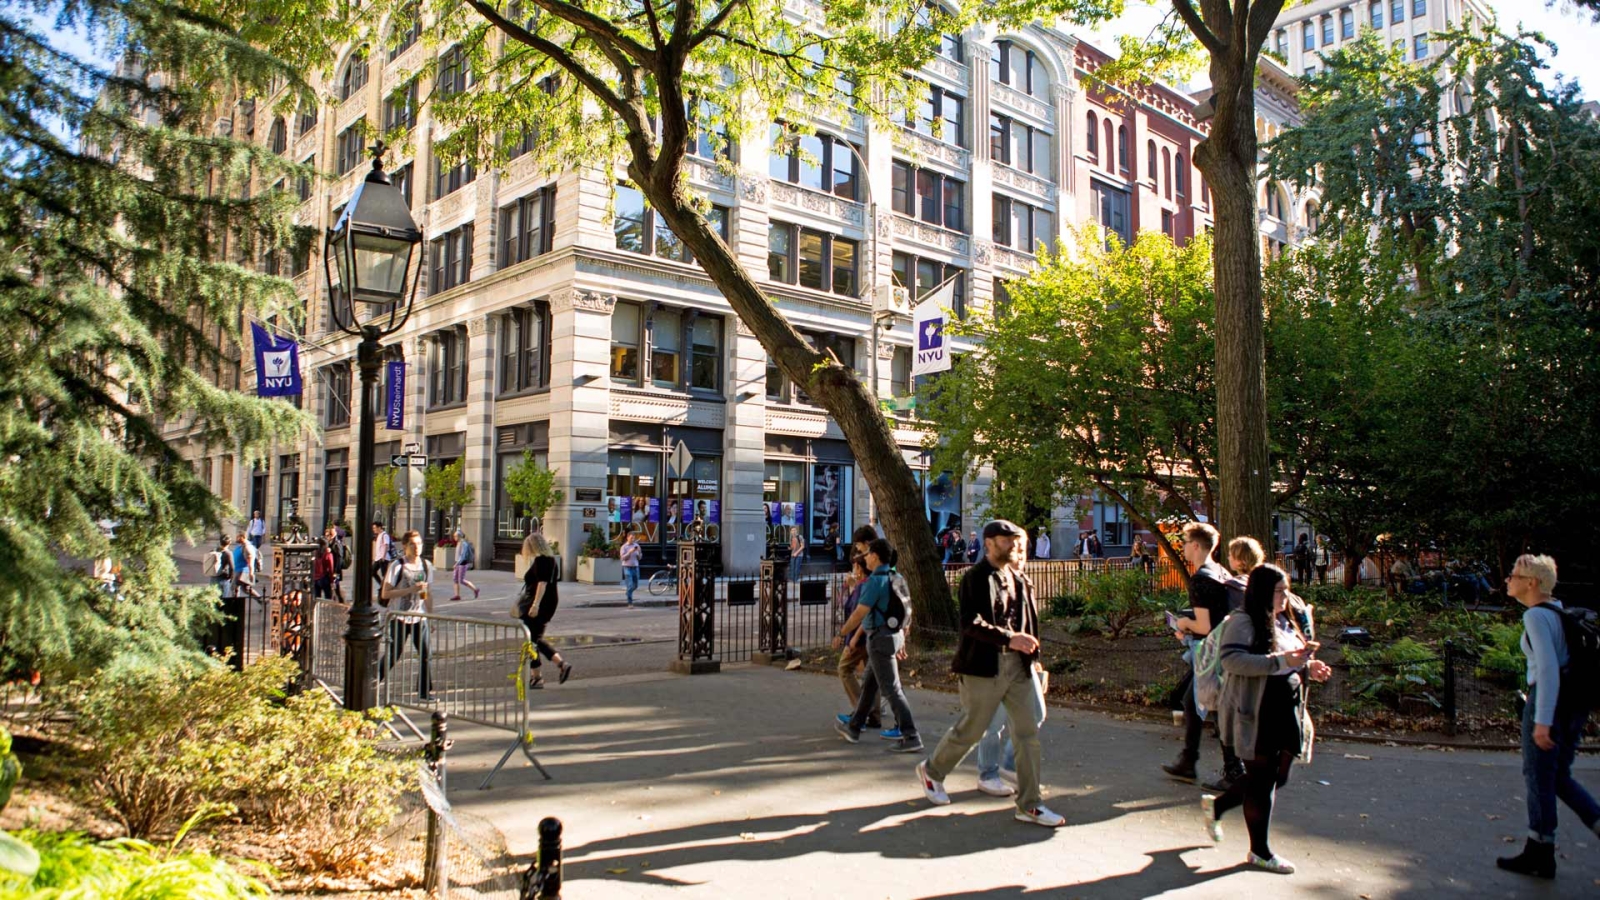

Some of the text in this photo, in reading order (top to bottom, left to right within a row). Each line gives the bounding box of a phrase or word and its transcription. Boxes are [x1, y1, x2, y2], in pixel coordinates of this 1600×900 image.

[918, 350, 943, 364] NYU
[265, 377, 293, 388] NYU
[392, 366, 402, 427] NYUSteinhardt
[585, 508, 595, 517] 82
